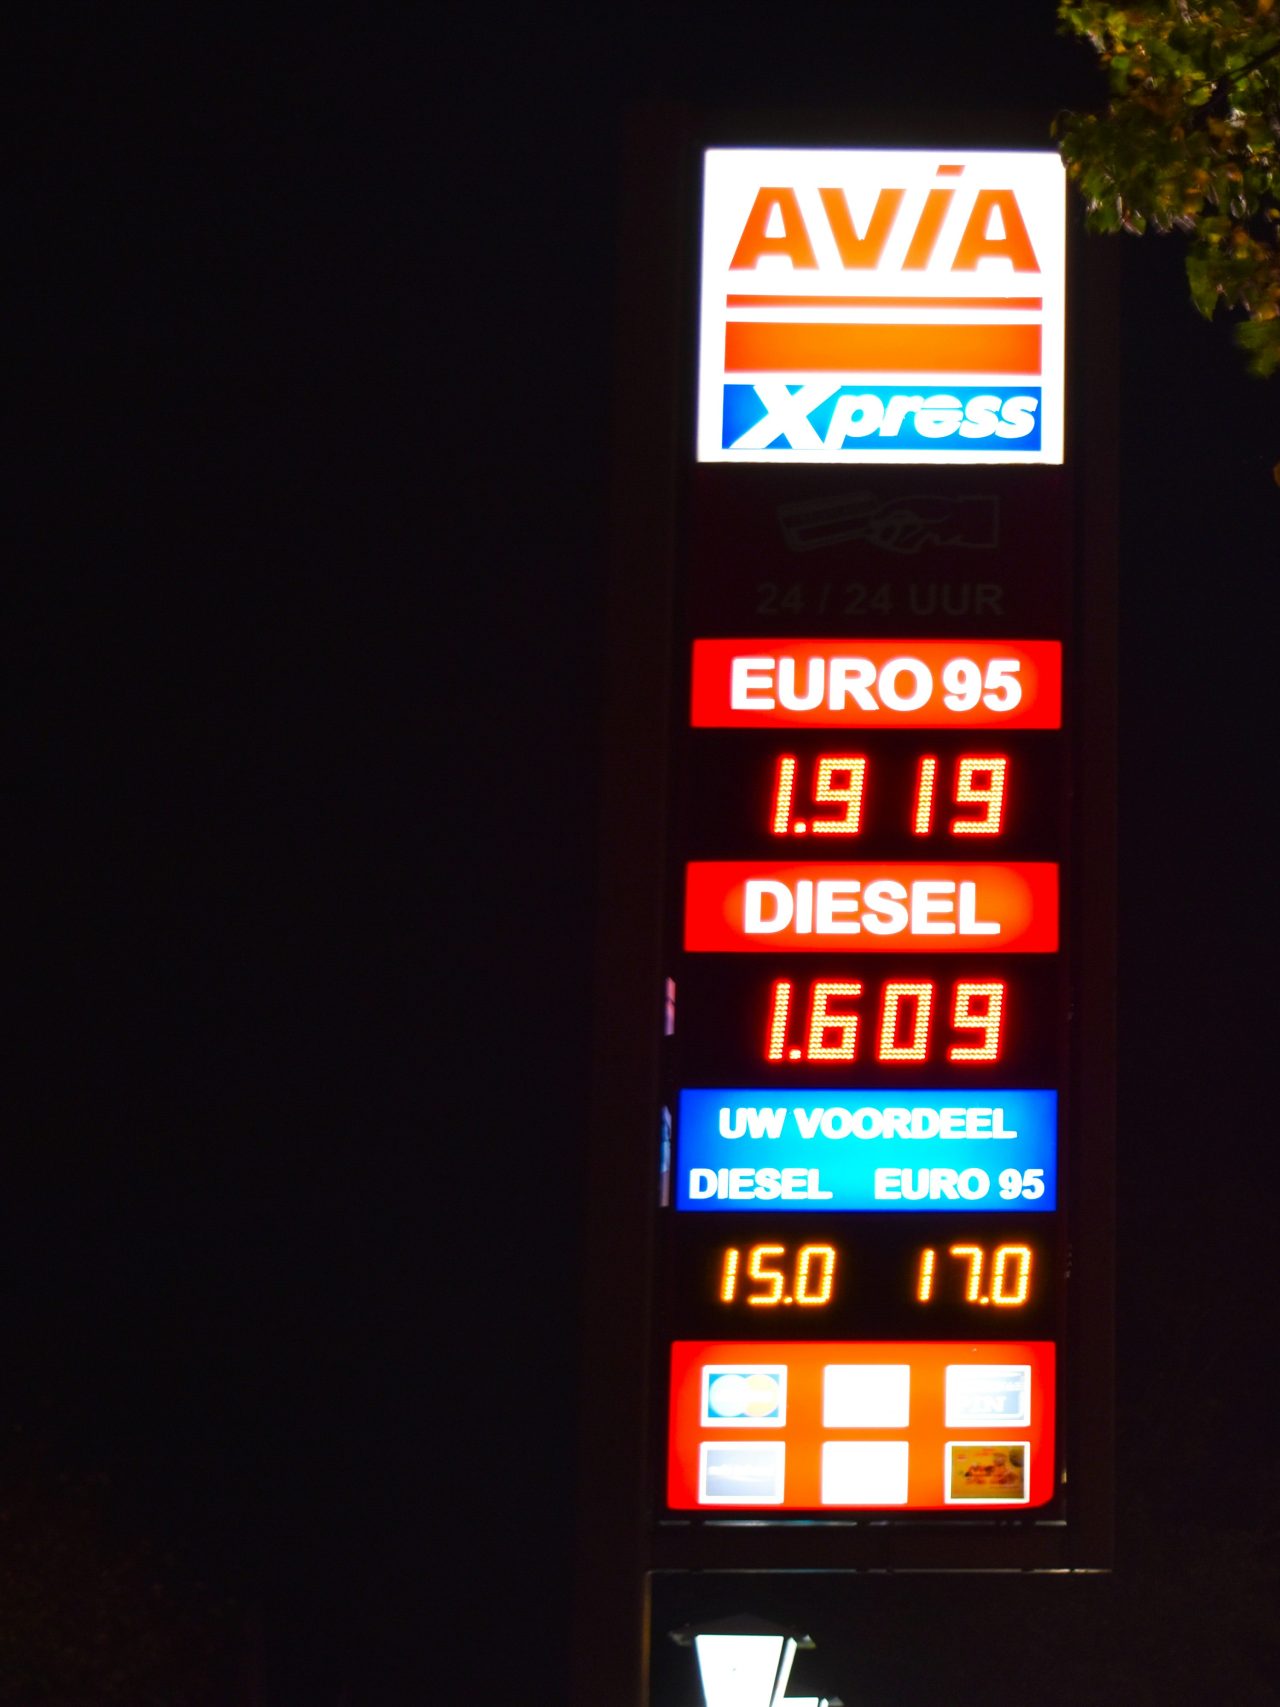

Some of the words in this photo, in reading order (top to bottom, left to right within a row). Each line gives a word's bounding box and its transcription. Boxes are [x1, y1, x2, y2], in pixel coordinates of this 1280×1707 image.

[730, 385, 1039, 449] Xpress
[756, 582, 806, 616] 24
[844, 582, 895, 616] 24
[908, 583, 1006, 616] UUR
[731, 658, 933, 711] EURO
[942, 658, 1022, 712] 95
[772, 756, 1008, 835] 1.919
[744, 880, 1001, 935] DIESEL
[767, 982, 1005, 1061] 1.609
[718, 1107, 788, 1140] UW
[793, 1107, 1018, 1140] VOORDEEL
[689, 1168, 833, 1200] DIESEL
[874, 1168, 991, 1201] EURO
[999, 1168, 1046, 1201] 95
[720, 1245, 837, 1305] 15.0
[917, 1245, 1032, 1305] 17.0
